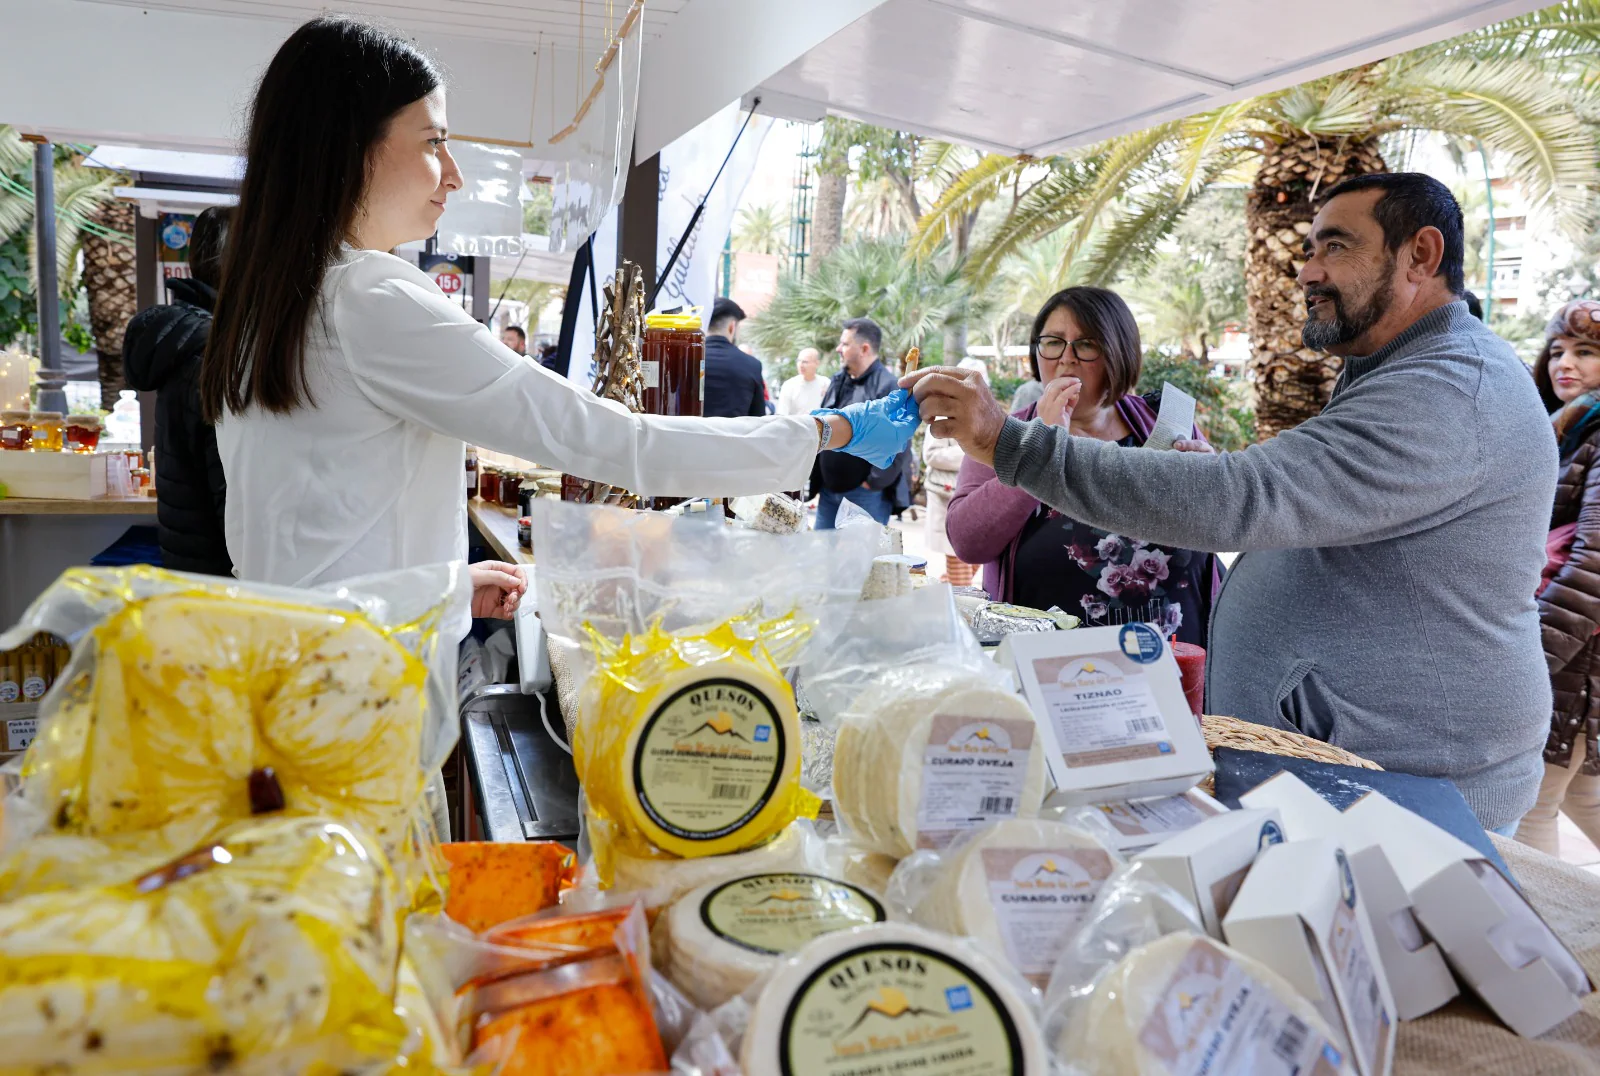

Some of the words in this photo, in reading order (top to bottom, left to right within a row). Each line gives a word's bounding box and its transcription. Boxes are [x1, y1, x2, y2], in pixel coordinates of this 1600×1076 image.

[690, 688, 757, 712] QUESOS
[1074, 688, 1122, 701] TIZNAO
[977, 758, 1014, 769] OVEJA
[828, 956, 928, 990] QUESOS
